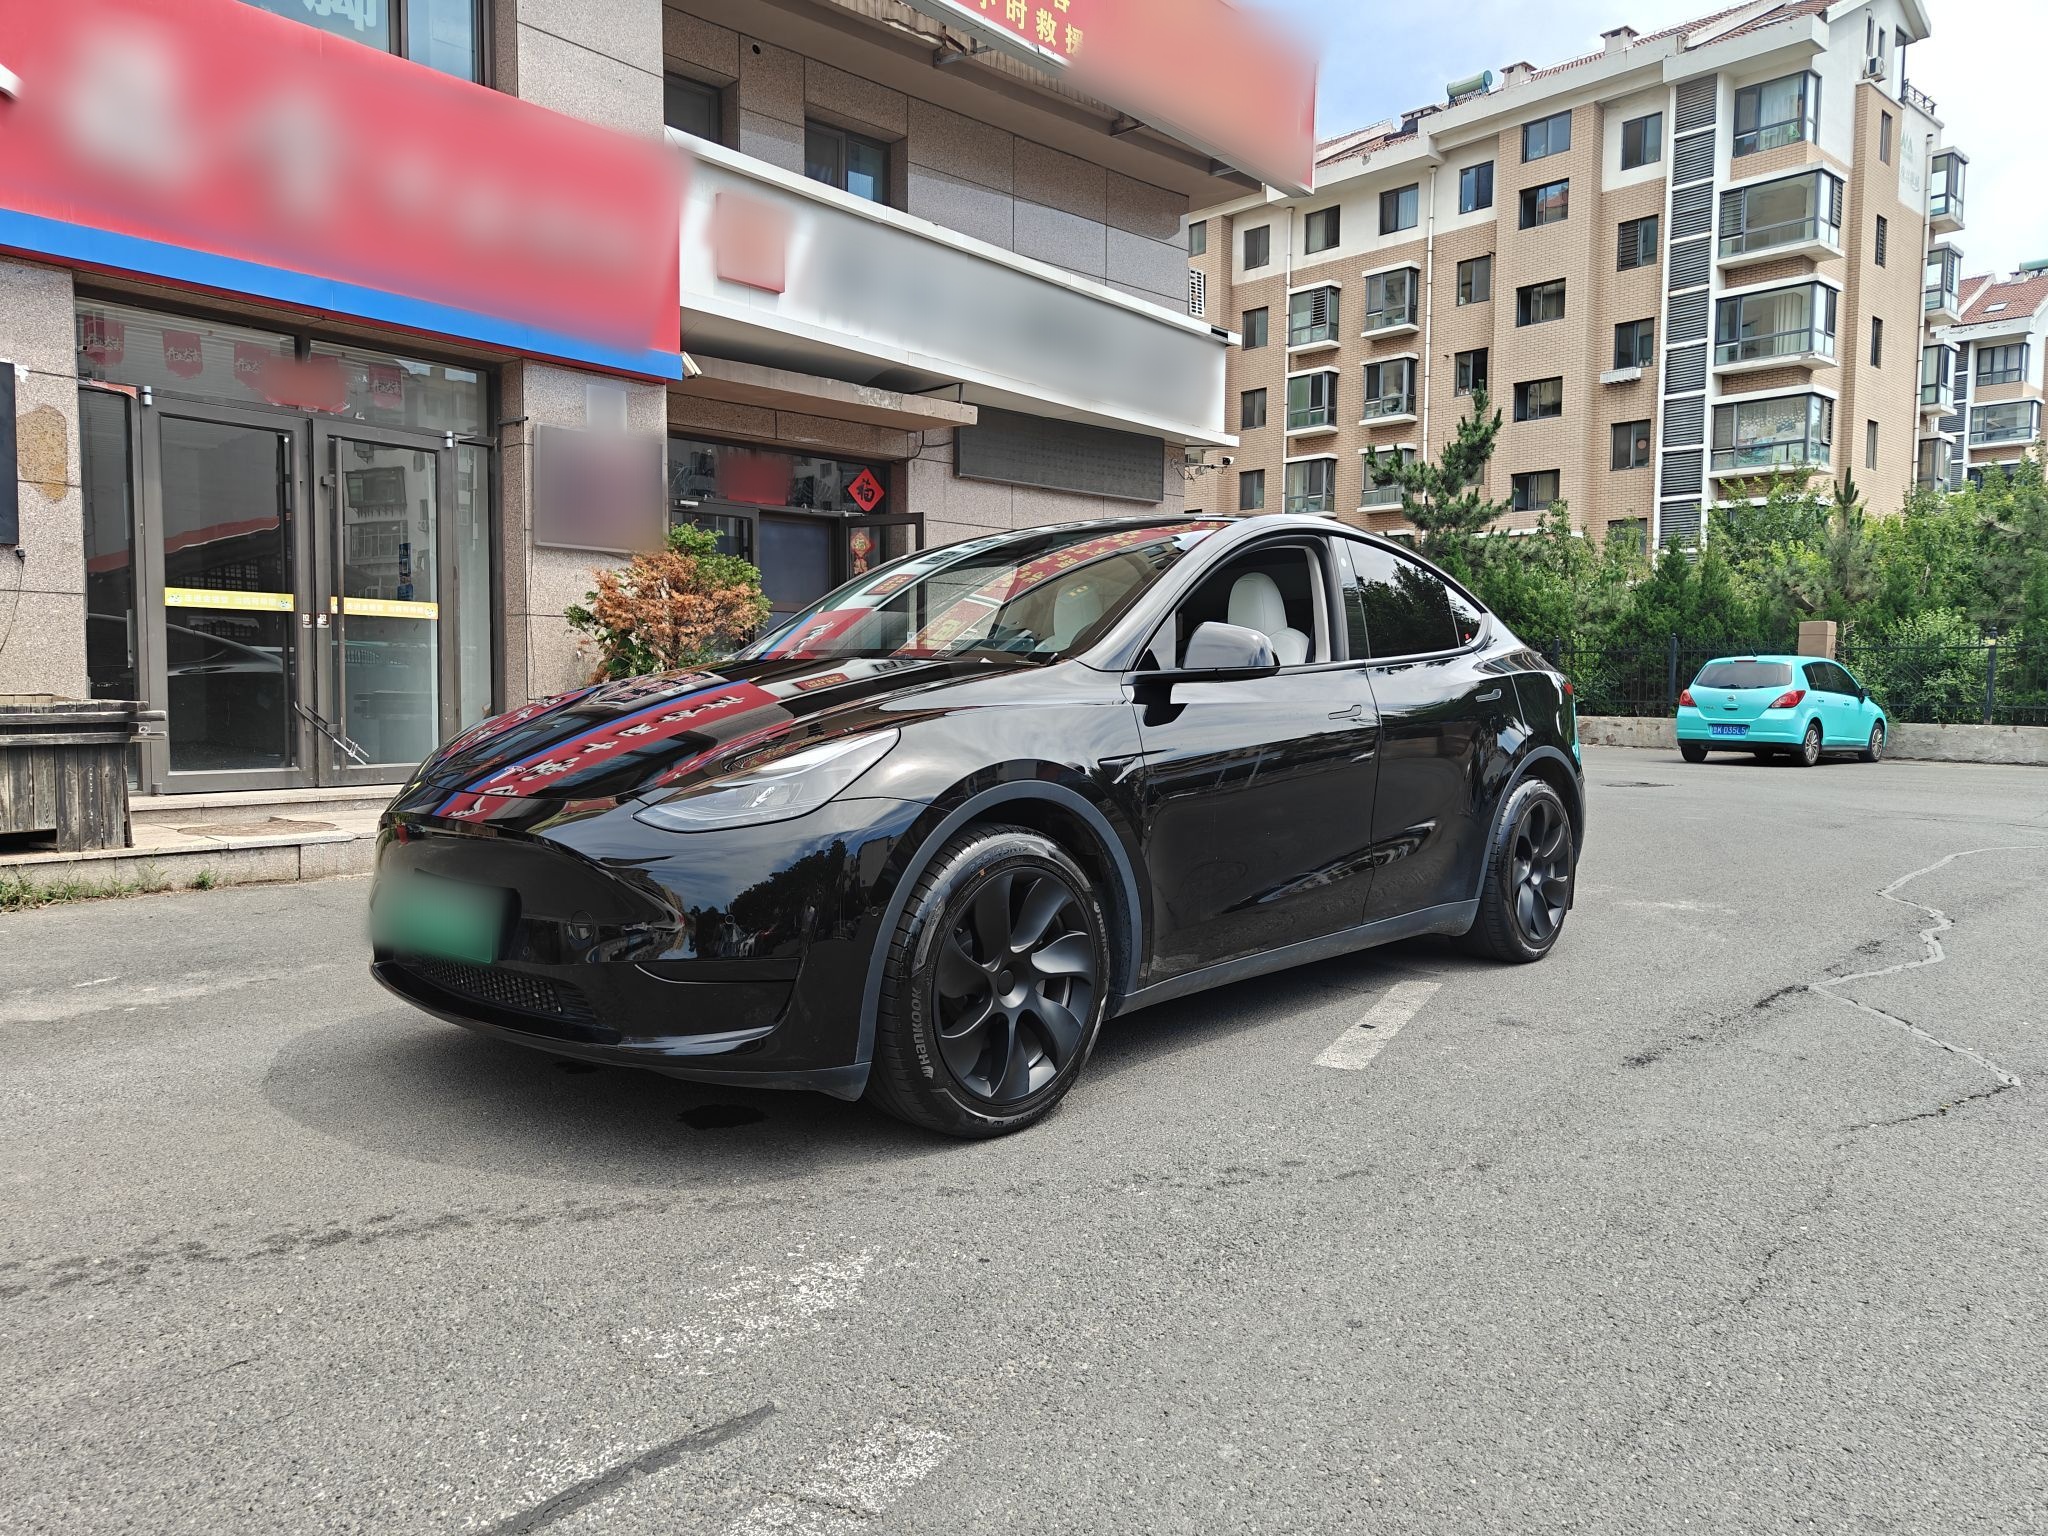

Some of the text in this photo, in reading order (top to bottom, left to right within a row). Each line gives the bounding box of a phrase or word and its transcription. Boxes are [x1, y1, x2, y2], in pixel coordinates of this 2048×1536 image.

[979, 0, 1084, 56] 时救援
[856, 478, 875, 502] 福
